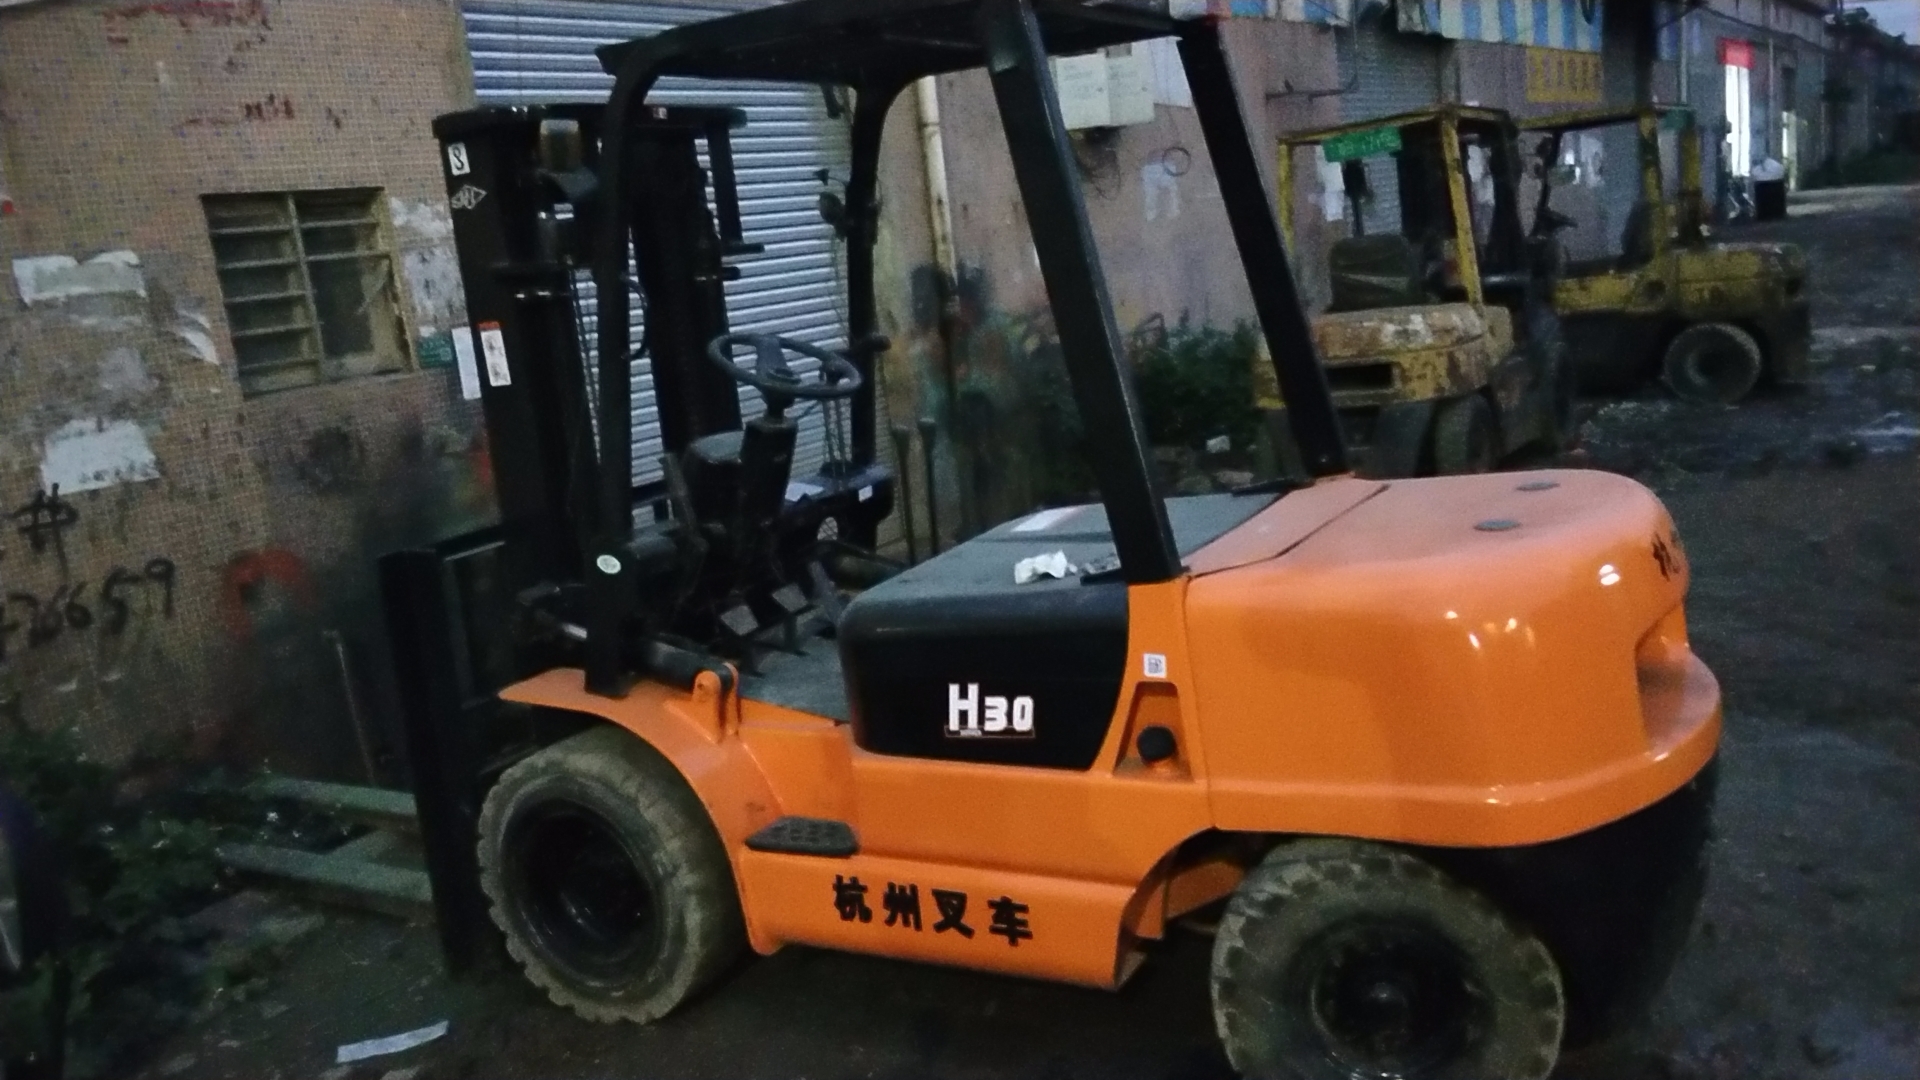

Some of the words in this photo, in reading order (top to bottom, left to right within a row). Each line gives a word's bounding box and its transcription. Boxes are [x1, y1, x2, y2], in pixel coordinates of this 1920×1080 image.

[948, 682, 1034, 732] H30
[832, 874, 1033, 946] 杭州叉车
